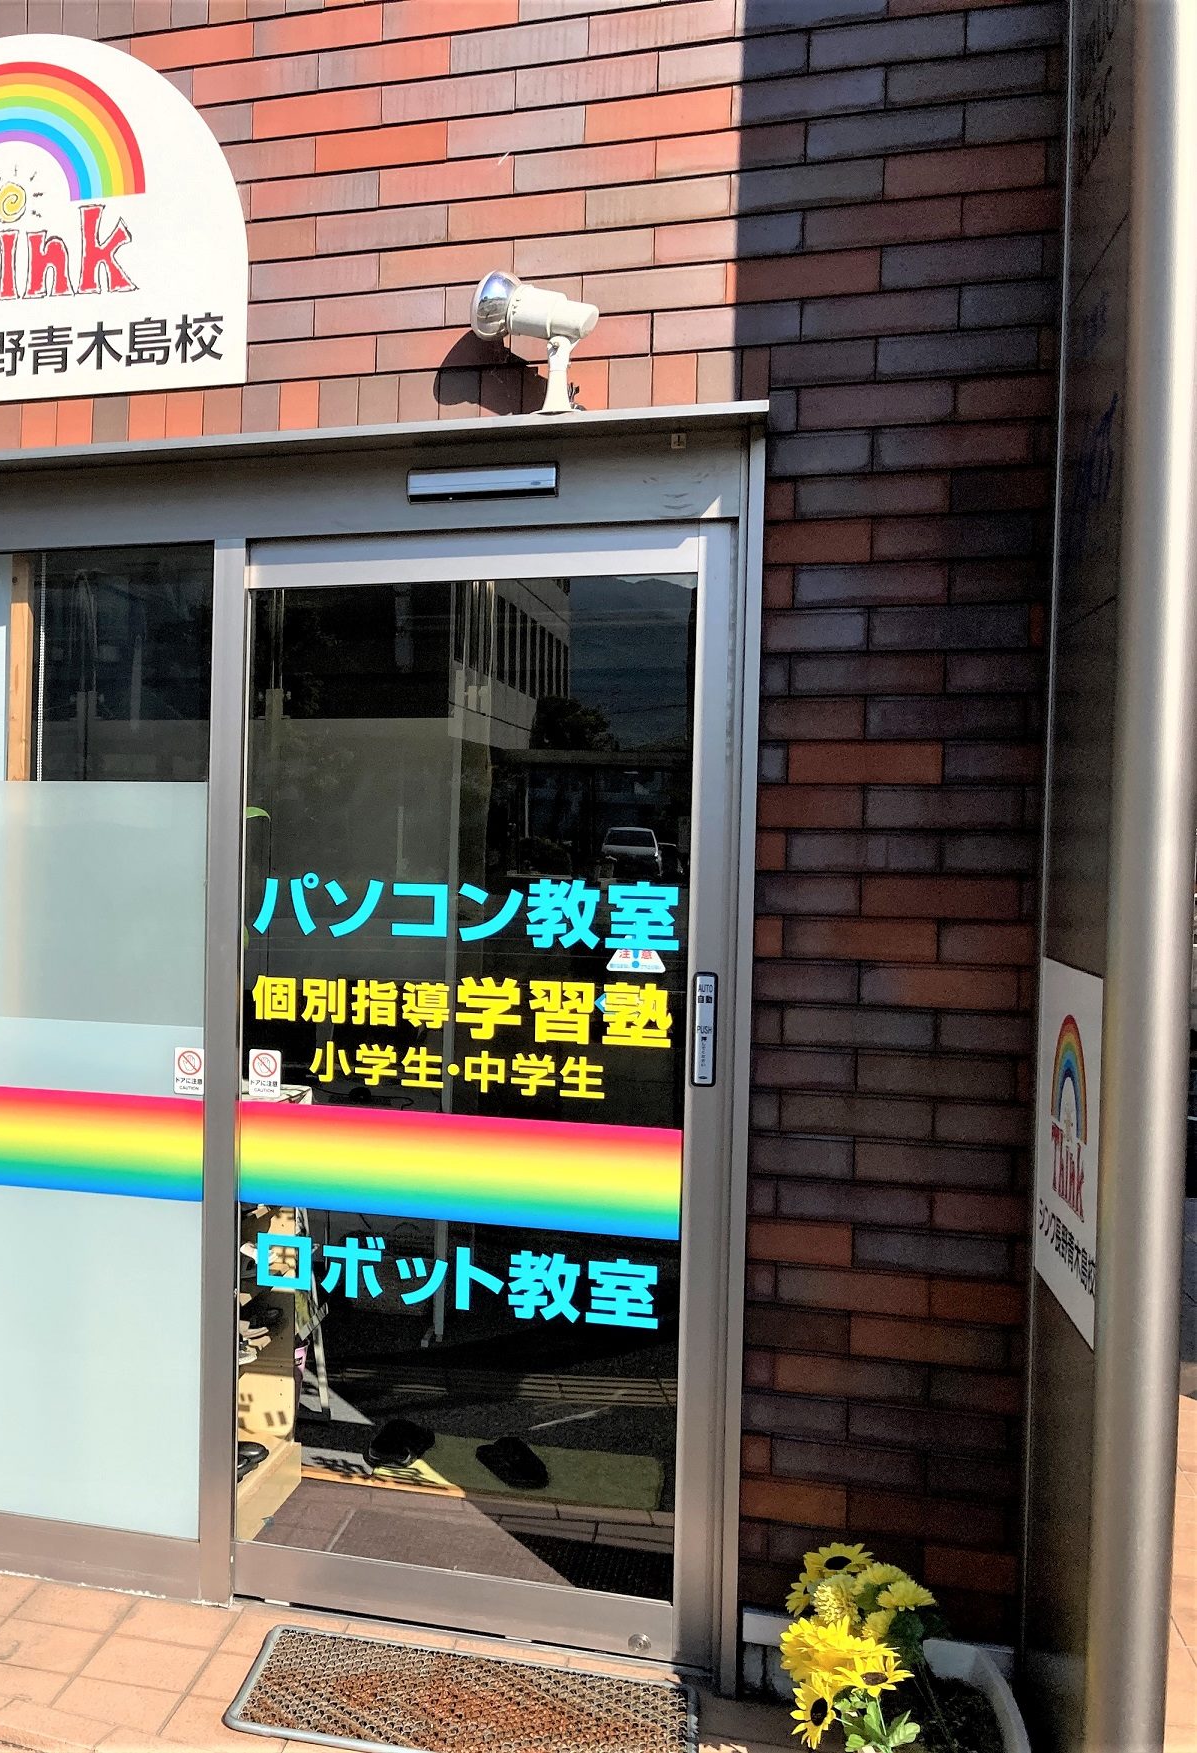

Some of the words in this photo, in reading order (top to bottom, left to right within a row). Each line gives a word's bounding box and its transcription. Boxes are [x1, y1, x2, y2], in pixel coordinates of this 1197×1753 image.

[252, 872, 680, 952] パソコン教室
[698, 984, 713, 993] AUTO
[698, 995, 713, 1004] 自動
[252, 974, 673, 1048] 個別指導学習塾
[697, 1026, 712, 1035] PUSH
[309, 1041, 606, 1099] 小学生・中学生
[175, 1077, 202, 1085] ドアに注意
[250, 1079, 278, 1088] ドアに注意
[256, 1232, 659, 1330] ロボット教室
